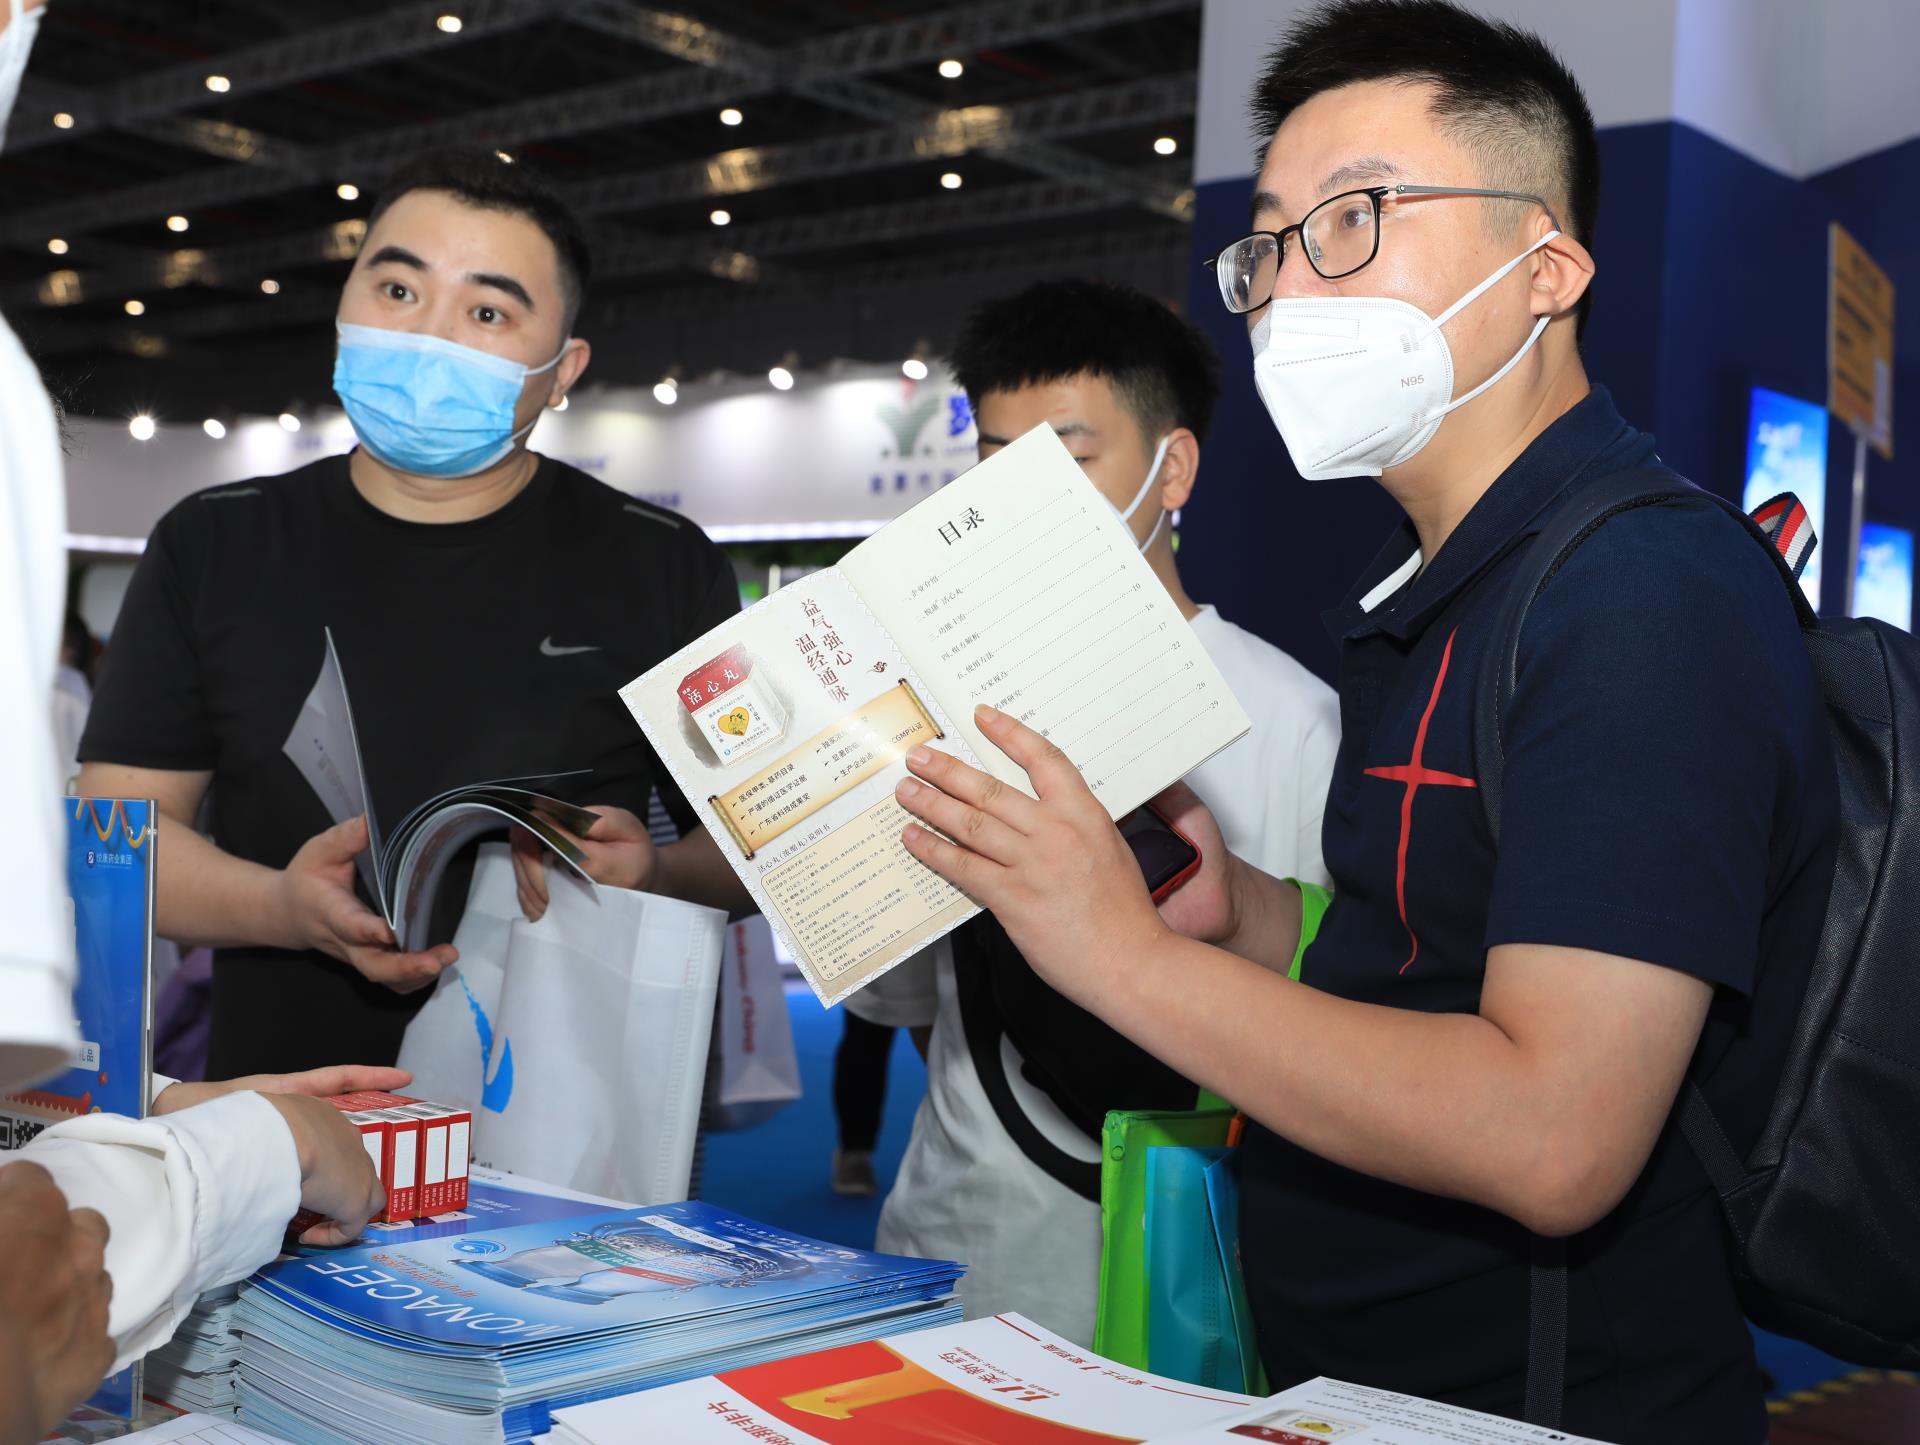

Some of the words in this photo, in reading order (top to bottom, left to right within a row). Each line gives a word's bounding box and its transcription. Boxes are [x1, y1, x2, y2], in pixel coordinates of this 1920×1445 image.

[1400, 374, 1425, 389] N95
[938, 505, 985, 546] 目录
[1131, 581, 1142, 592] 10
[1144, 601, 1155, 611] 16
[799, 596, 853, 668] 益气强心
[1157, 620, 1168, 631] 17
[1171, 639, 1182, 651] 22
[794, 632, 849, 705] 温经通脉
[1183, 659, 1195, 670] 23
[686, 665, 739, 705] 活心丸
[1195, 679, 1207, 690] 26
[1209, 698, 1220, 709] 29
[756, 791, 812, 830] 广东省科技成果奖
[305, 1261, 574, 1337] MONACEF
